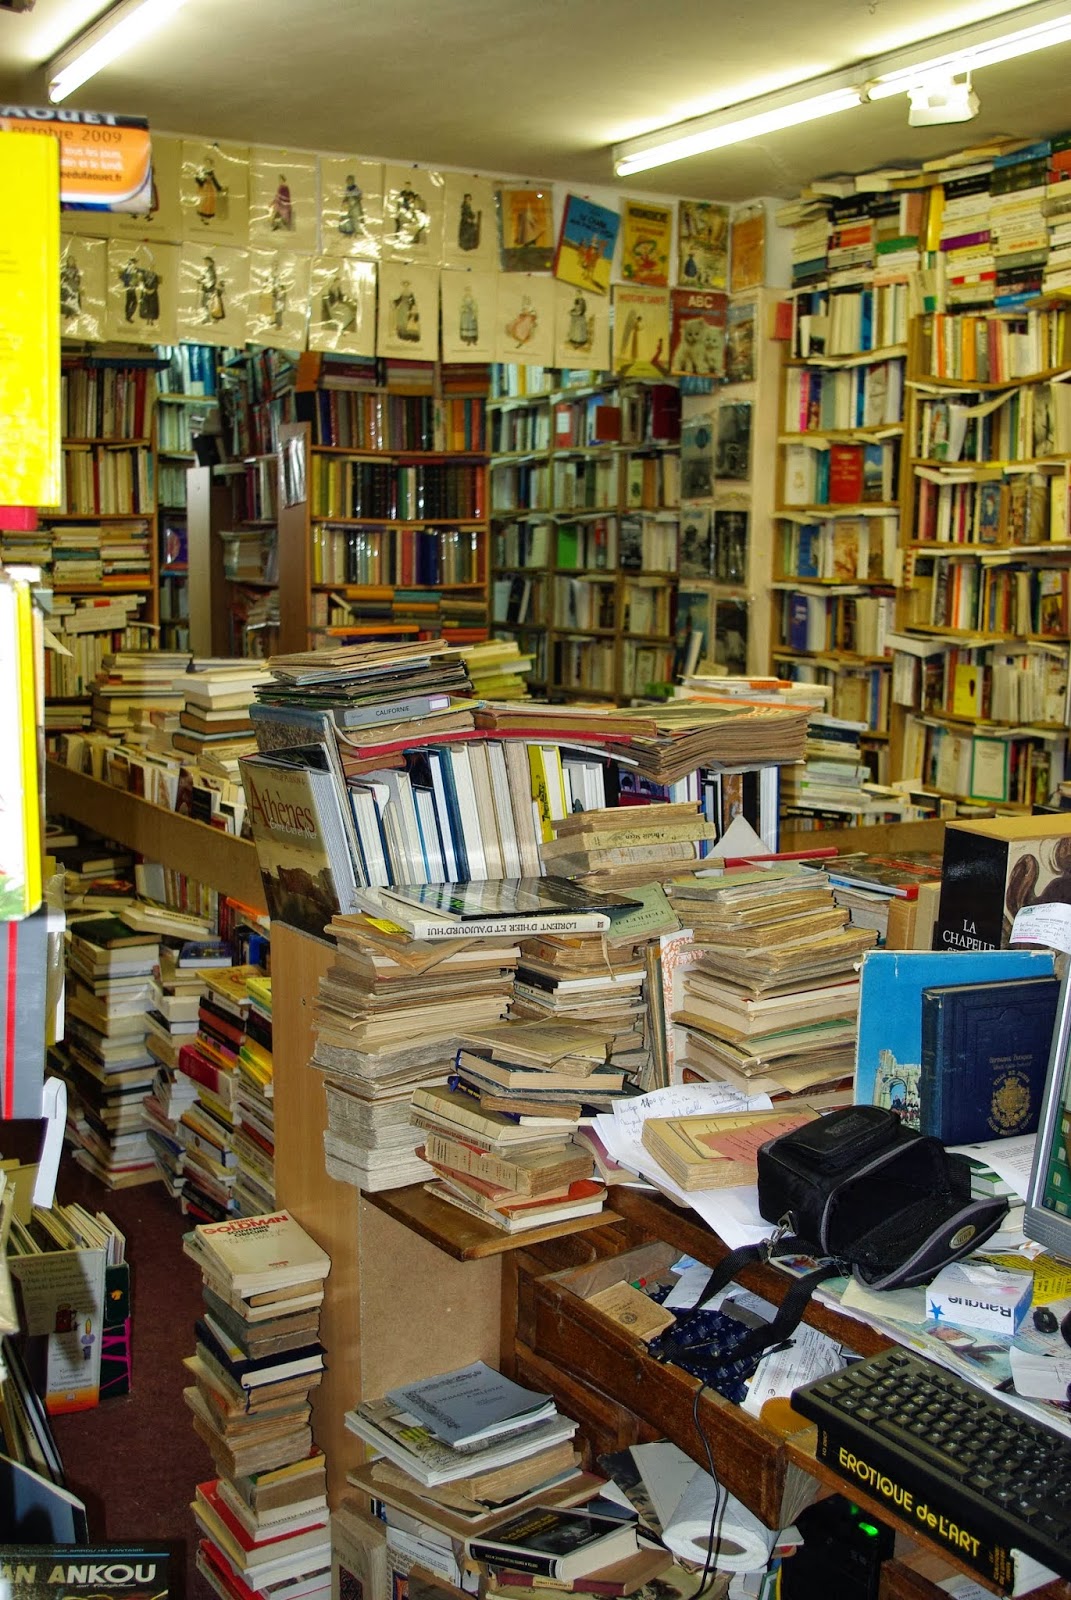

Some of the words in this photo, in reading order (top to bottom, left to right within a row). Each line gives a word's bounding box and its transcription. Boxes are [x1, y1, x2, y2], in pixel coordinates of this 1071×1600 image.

[81, 128, 122, 143] 2009
[688, 295, 713, 308] ABC
[375, 706, 410, 717] CALIFORNIE
[249, 776, 315, 833] Athènes
[427, 925, 493, 936] D'AUJOURD'HUI
[494, 924, 508, 934] ET
[509, 922, 538, 933] D'HIER
[540, 921, 577, 932] LORIENT
[963, 919, 977, 935] LA
[203, 1215, 289, 1235] GOLDMAN
[838, 1446, 913, 1512] EROTIQUE
[48, 1563, 157, 1584] ANKOU
